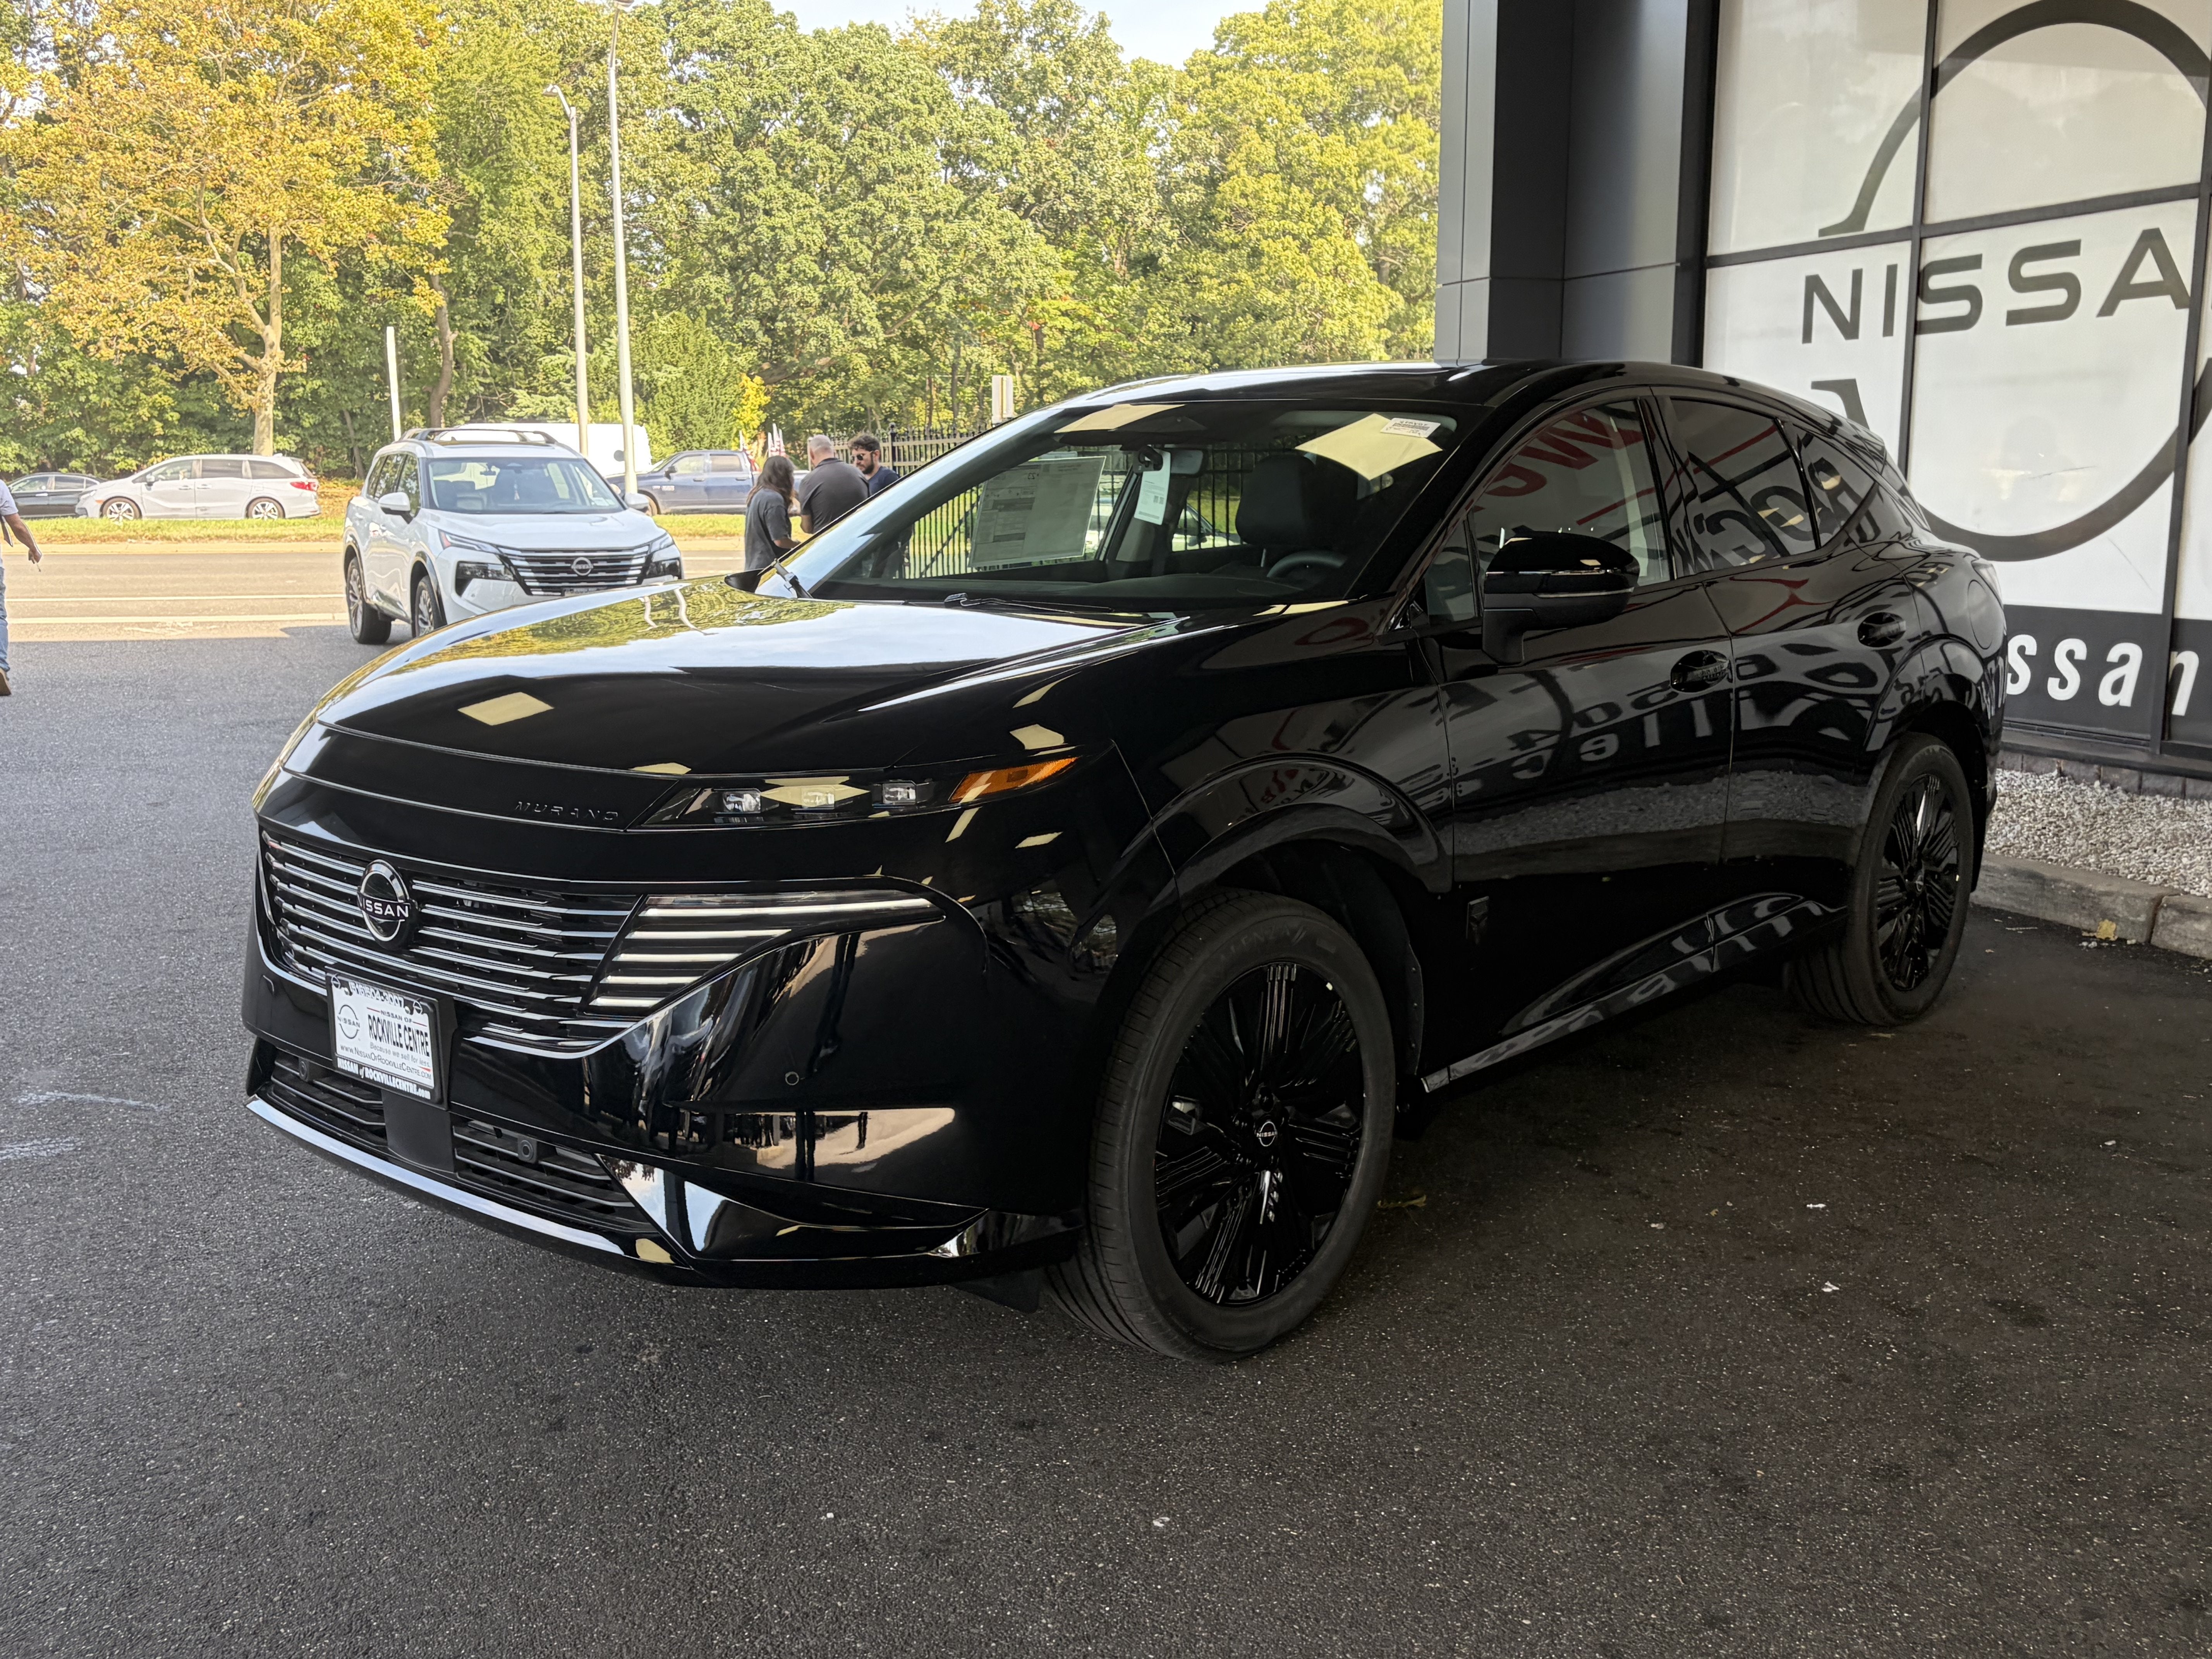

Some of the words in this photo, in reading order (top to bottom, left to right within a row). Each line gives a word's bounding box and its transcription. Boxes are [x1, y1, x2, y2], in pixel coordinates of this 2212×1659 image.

[1802, 227, 2190, 344] NISSA
[514, 801, 619, 821] MURANO
[357, 893, 409, 918] NISSAN
[337, 1015, 361, 1028] NISSAN
[381, 1010, 403, 1021] NISSAN
[368, 1014, 403, 1049] ROCKVILLE
[404, 1025, 430, 1057] CENTRE
